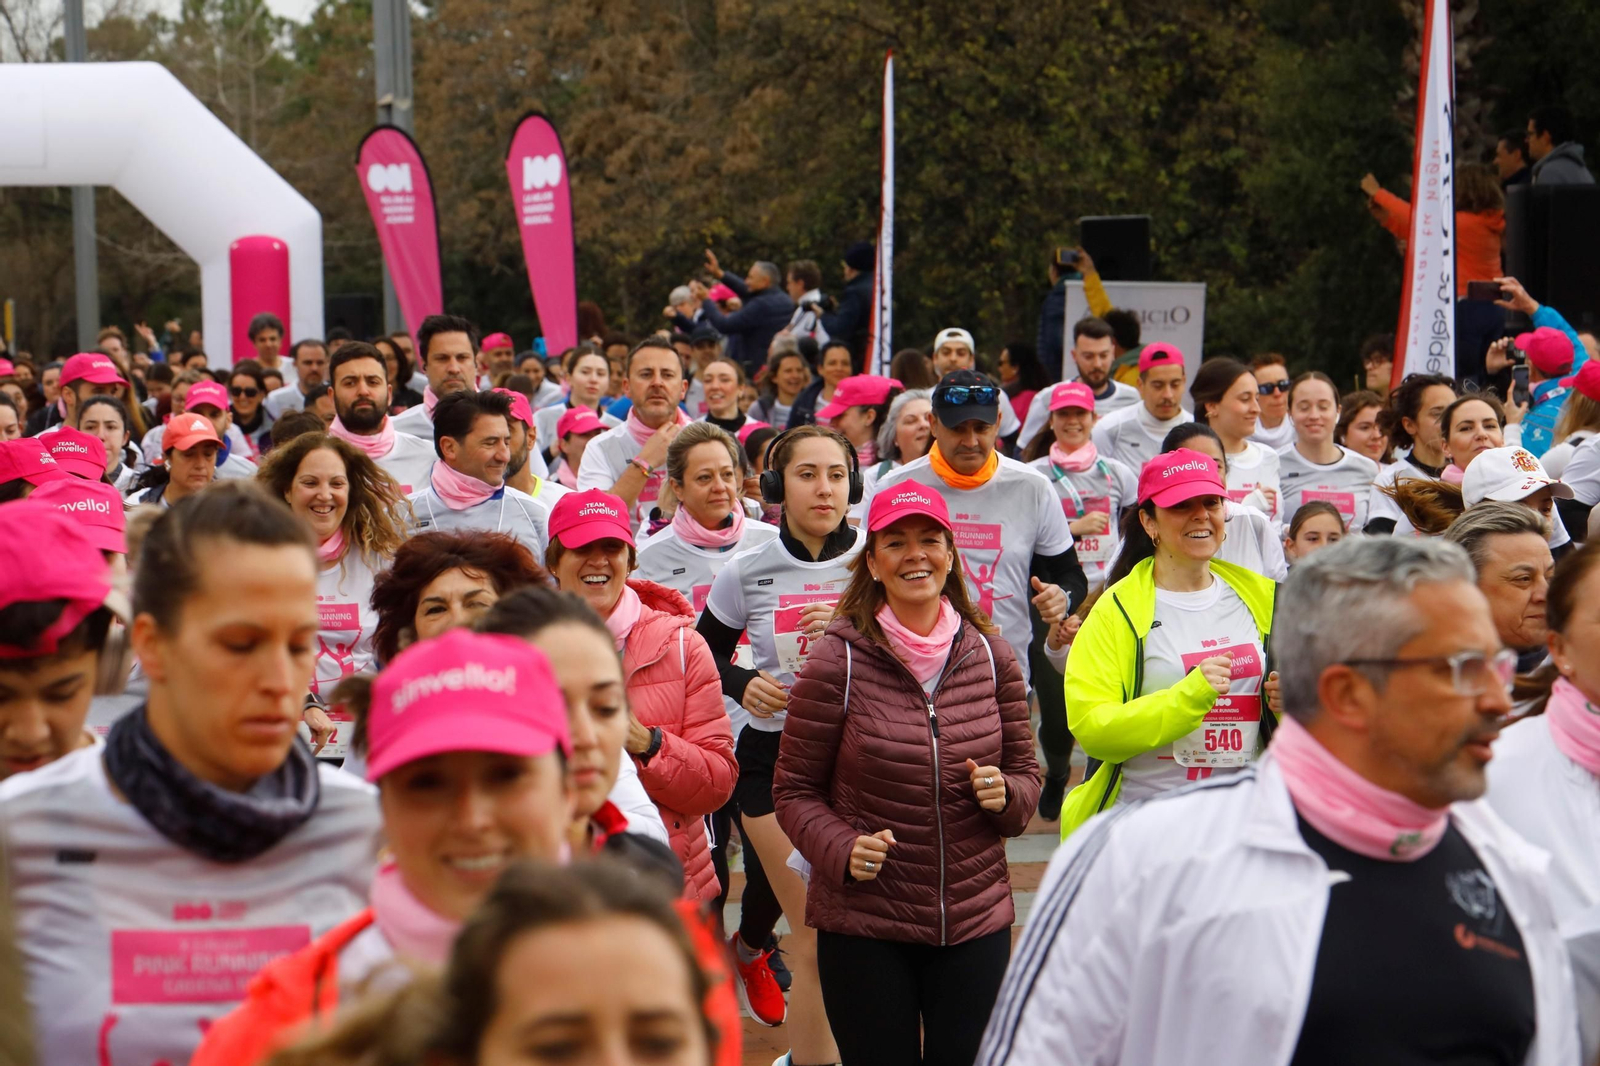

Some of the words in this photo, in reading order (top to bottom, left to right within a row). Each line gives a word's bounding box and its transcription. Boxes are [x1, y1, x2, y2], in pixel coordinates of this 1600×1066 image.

[523, 154, 562, 190] 100
[52, 445, 88, 454] sinvello!
[1162, 460, 1209, 478] sinvello!
[58, 499, 110, 514] nvello!
[891, 496, 931, 506] sinvello!
[579, 507, 618, 518] sinvello!
[960, 531, 994, 540] RUNNING
[804, 583, 821, 591] 100
[796, 635, 808, 656] 2
[1201, 639, 1217, 648] 100
[1230, 655, 1254, 667] NNING
[391, 661, 516, 714] sinvello!
[1215, 698, 1232, 707] 100
[1204, 728, 1243, 752] 540
